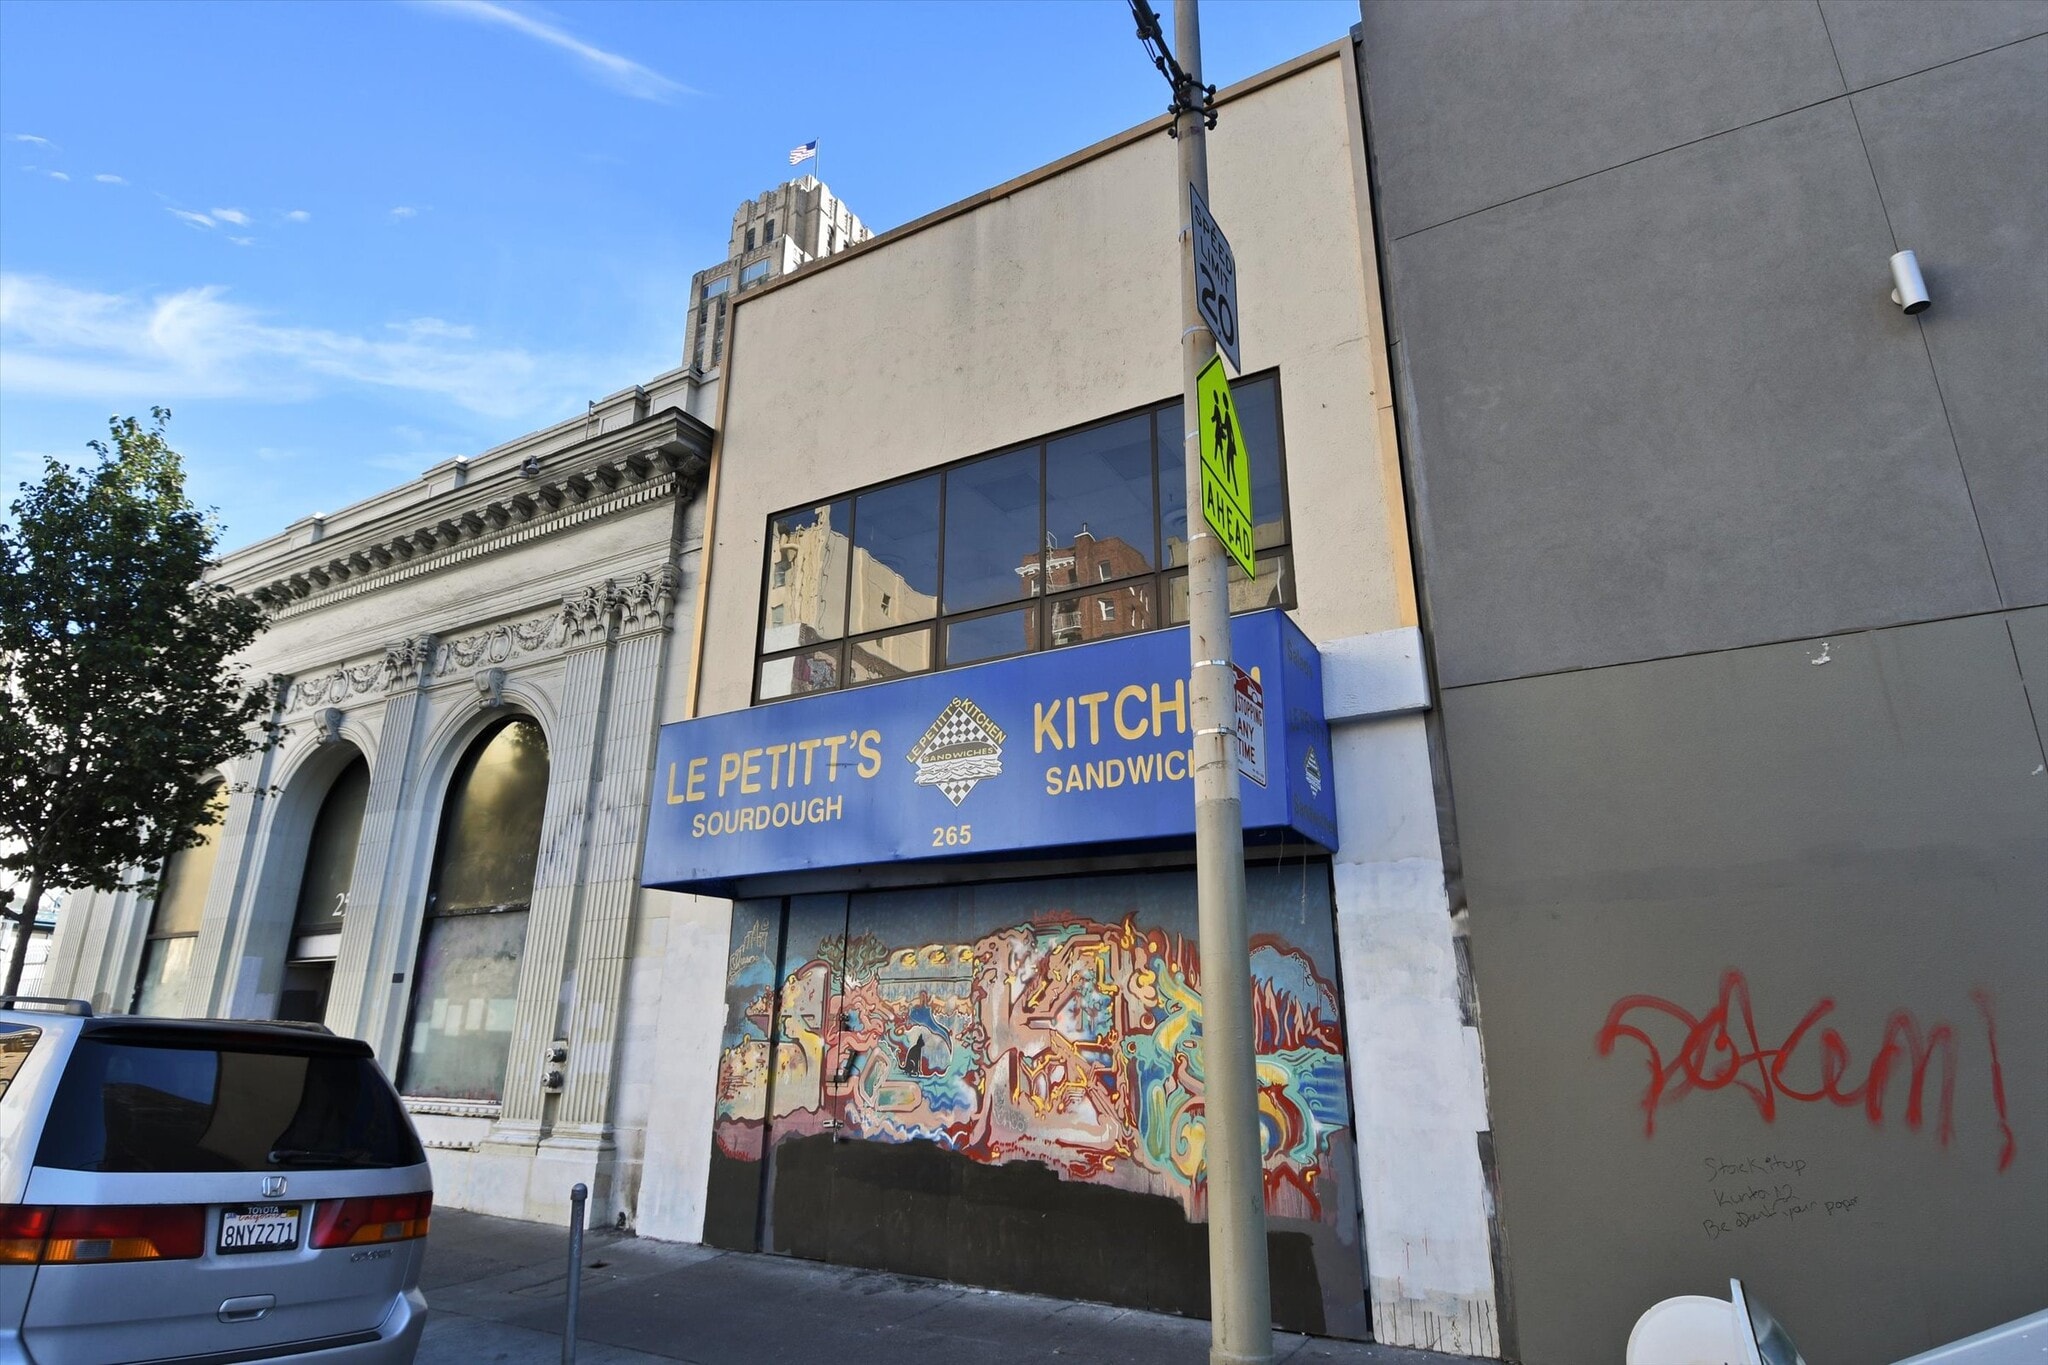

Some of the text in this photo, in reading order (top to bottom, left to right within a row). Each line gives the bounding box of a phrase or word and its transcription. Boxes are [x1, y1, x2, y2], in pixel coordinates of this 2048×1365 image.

[1195, 204, 1232, 275] SPEED
[1200, 235, 1230, 293] LIMIT
[1200, 262, 1234, 346] 20
[1207, 480, 1250, 560] AHEAD
[1237, 694, 1262, 727] STOPPING
[906, 746, 922, 763] LE
[961, 698, 1007, 744] KITCHEN
[1237, 718, 1254, 742] ANY
[666, 729, 882, 805] LE PETITT'S
[923, 748, 994, 763] SANDWICHES
[1238, 737, 1256, 765] TIME
[692, 795, 843, 838] SOURDOUGH
[932, 825, 972, 847] 265
[248, 1206, 279, 1214] TOYOTA
[225, 1222, 293, 1246] 8NYZ271
